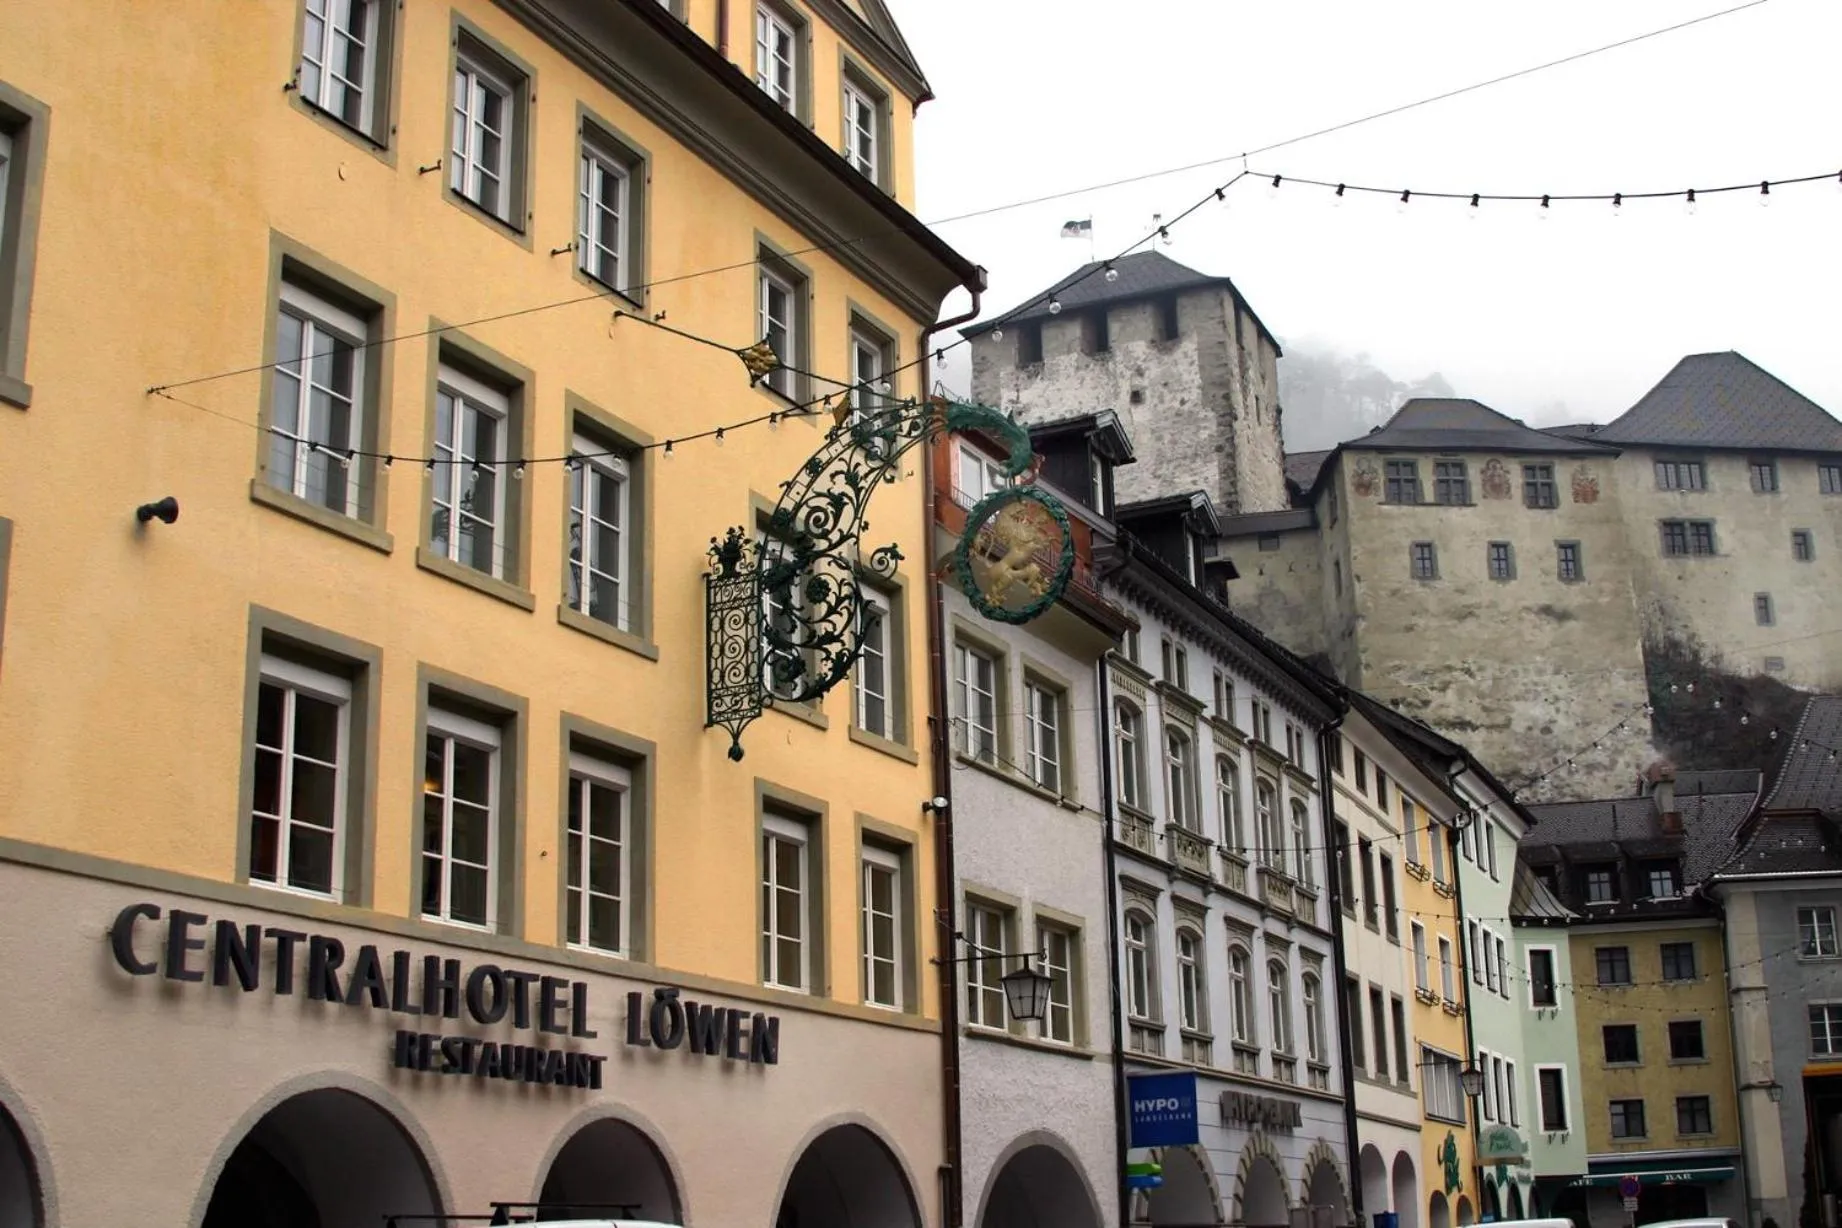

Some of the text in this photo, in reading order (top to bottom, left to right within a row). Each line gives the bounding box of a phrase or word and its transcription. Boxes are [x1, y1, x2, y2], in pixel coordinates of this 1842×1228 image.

[110, 902, 780, 1065] CENTRALHOTEL LÖWEN
[394, 1030, 608, 1090] RESTAURANT
[1133, 1097, 1180, 1113] HYPO
